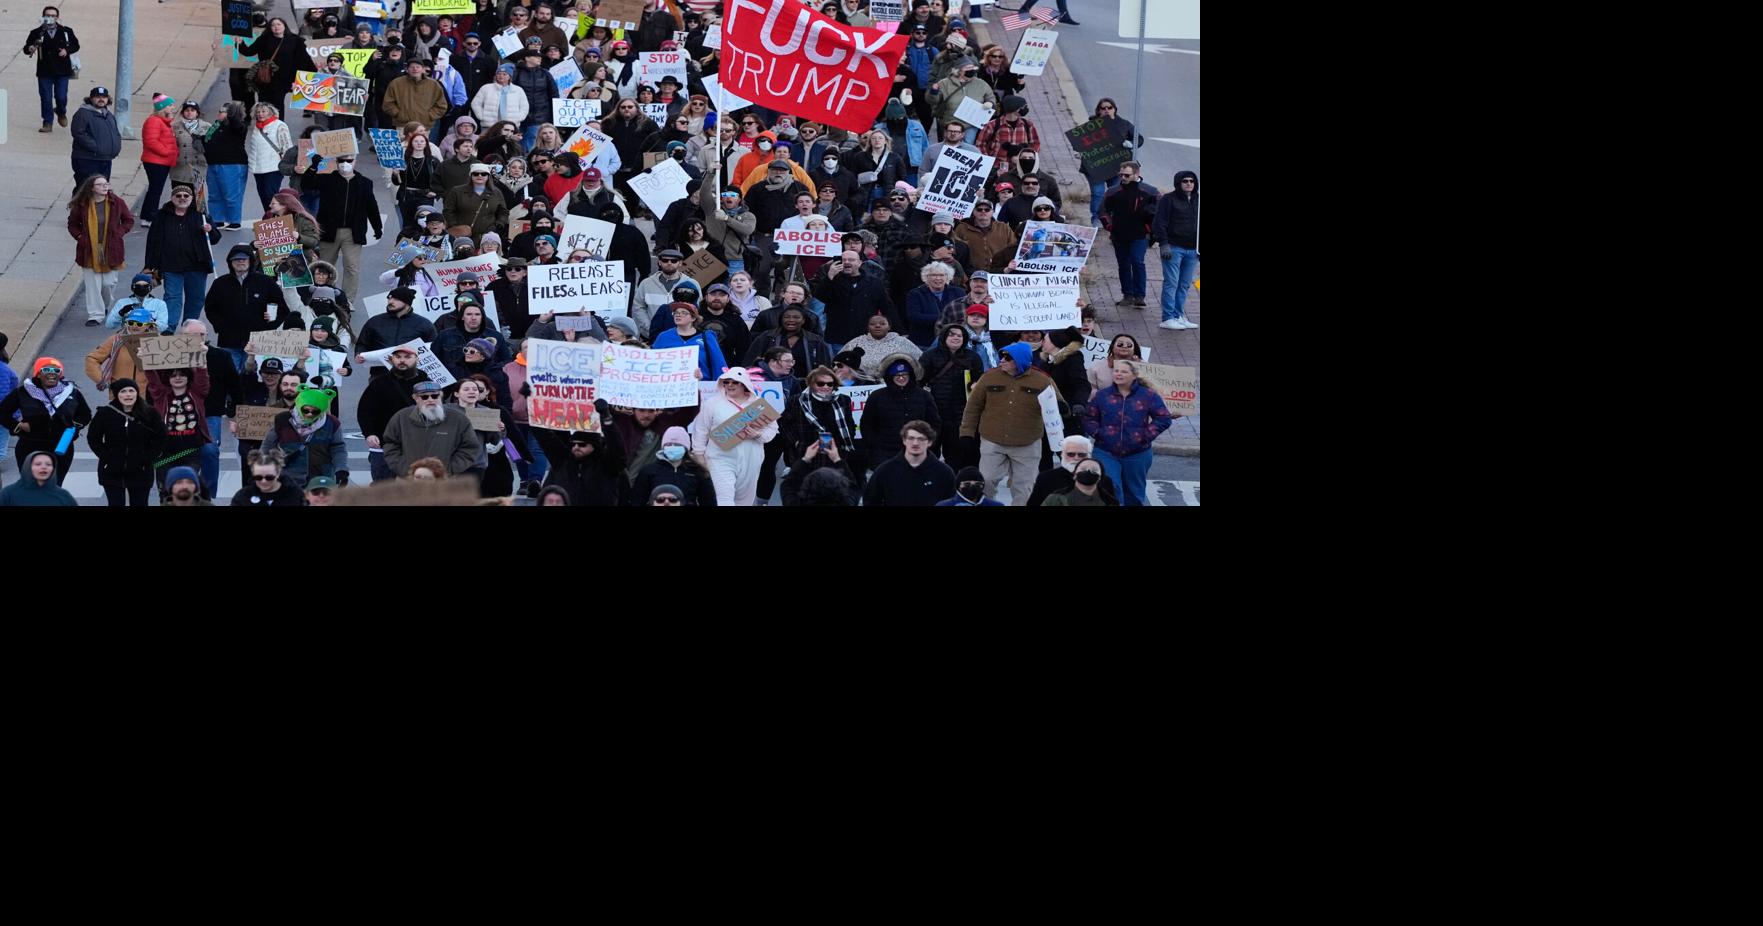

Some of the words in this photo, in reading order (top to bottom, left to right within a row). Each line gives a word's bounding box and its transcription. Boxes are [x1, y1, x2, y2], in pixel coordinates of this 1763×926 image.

[727, 0, 897, 80] FUCK
[1025, 41, 1049, 49] MAGA
[347, 53, 366, 62] TOP
[649, 53, 680, 63] STOP
[727, 41, 871, 116] TRUMP
[337, 81, 366, 105] FEAR
[1072, 118, 1105, 137] STOP
[944, 147, 983, 174] BREAK
[928, 166, 985, 204] ICE
[924, 194, 969, 210] KIDNAPPING
[259, 220, 284, 231] THEY
[258, 227, 290, 241] BLAME
[775, 230, 842, 243] ABOLIS
[263, 248, 273, 256] SO
[275, 244, 294, 255] YOU
[796, 244, 826, 255] ICE
[436, 267, 464, 277] HUMAN
[465, 263, 493, 274] RIGHTS
[692, 253, 715, 272] ICE
[1017, 261, 1057, 272] ABOLISH
[548, 264, 616, 282] RELEASE
[1045, 275, 1079, 286] MIGRA
[580, 279, 624, 297] LEAKS
[994, 291, 1010, 300] NO
[1014, 290, 1045, 300] HUMAN
[425, 296, 452, 312] ICE
[1000, 314, 1018, 325] ON
[143, 337, 193, 353] FUCK
[603, 345, 693, 360] ABOLISH
[532, 344, 596, 378] ICE
[624, 361, 673, 373] ICE
[530, 372, 557, 384] melts
[560, 375, 581, 384] when
[582, 377, 594, 385] we
[600, 361, 691, 384] PROSECUTE
[533, 384, 560, 398] TURN
[562, 386, 575, 400] UP
[575, 386, 595, 400] THE
[532, 399, 595, 430] HEAT
